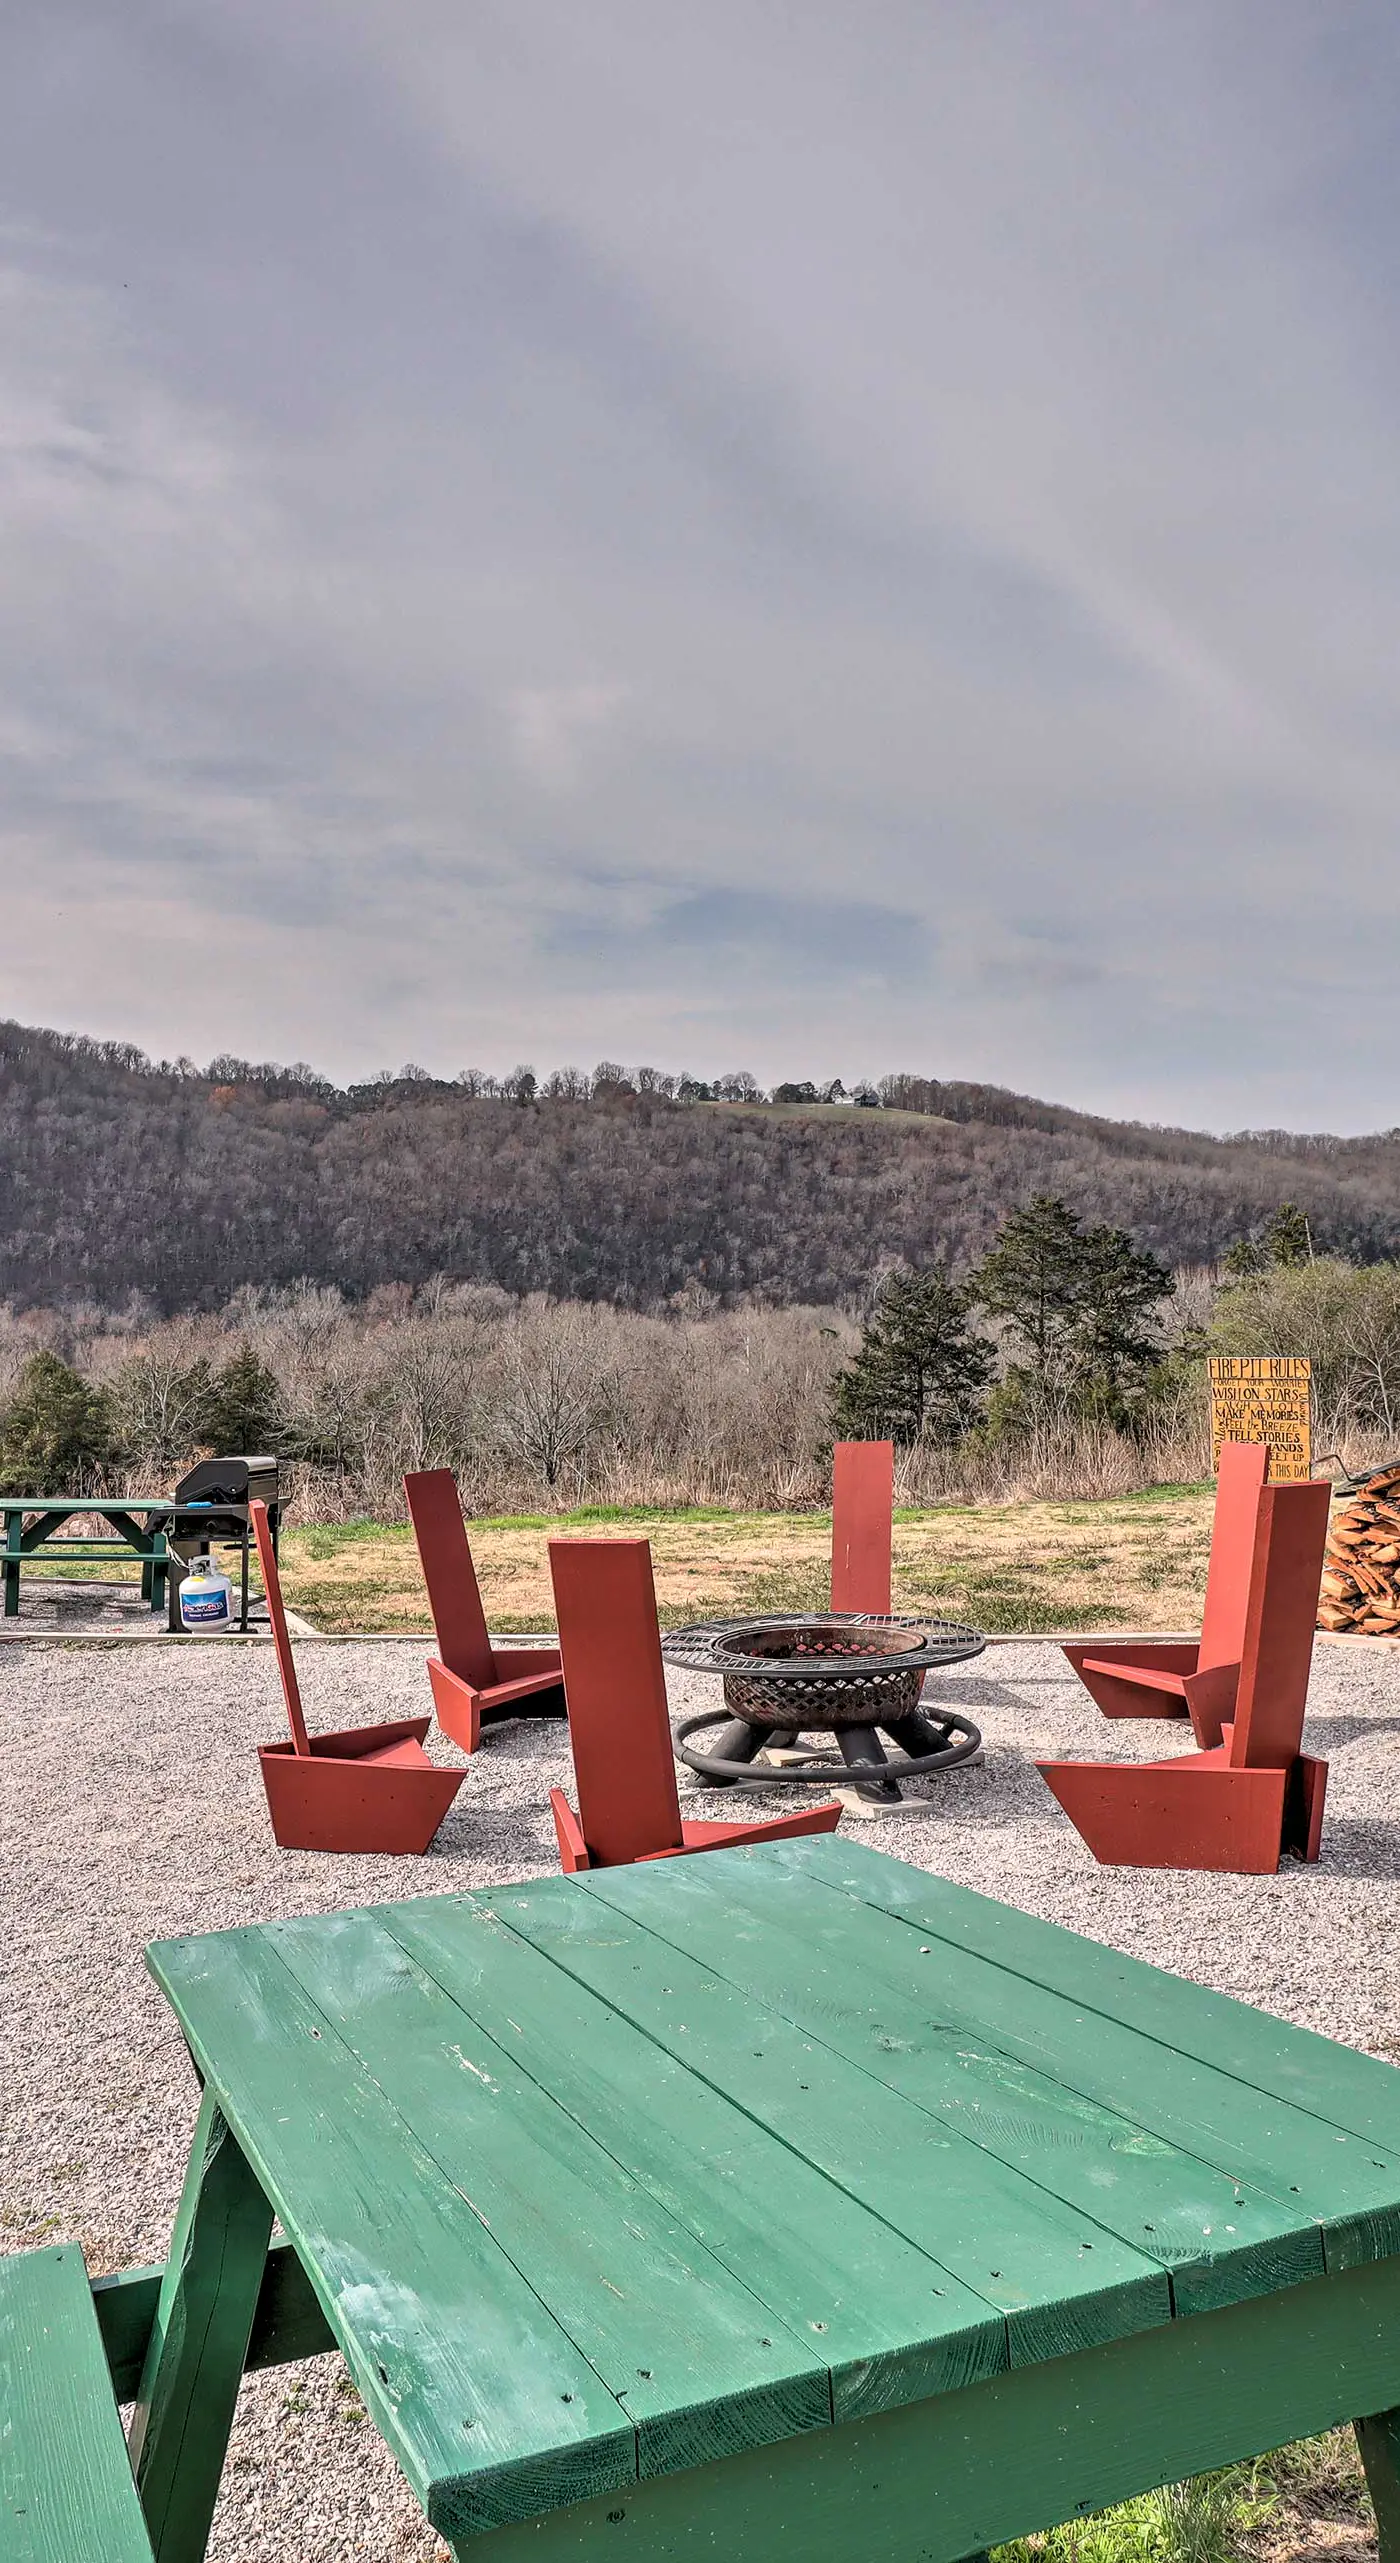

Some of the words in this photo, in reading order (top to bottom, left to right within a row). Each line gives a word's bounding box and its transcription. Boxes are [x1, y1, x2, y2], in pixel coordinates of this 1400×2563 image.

[1270, 1358, 1309, 1378] RULES
[1213, 1378, 1240, 1387] FORGET
[1246, 1378, 1264, 1387] YOUR
[1271, 1379, 1306, 1388] WORRIES
[1212, 1387, 1241, 1400] WISH
[1243, 1387, 1260, 1400] ON
[1265, 1388, 1298, 1401] STARS
[1215, 1400, 1250, 1411] LAUGH
[1257, 1402, 1265, 1411] A
[1271, 1402, 1294, 1411] LOT
[1215, 1409, 1245, 1419] MAKE
[1251, 1409, 1299, 1421] MEMORIES
[1261, 1419, 1298, 1432] BREEZE
[1227, 1430, 1253, 1441] TELL
[1256, 1430, 1300, 1443] STORIES
[1269, 1452, 1289, 1461] EET
[1293, 1453, 1304, 1462] UP
[1276, 1464, 1291, 1478] THIS
[1294, 1464, 1309, 1478] DAY
